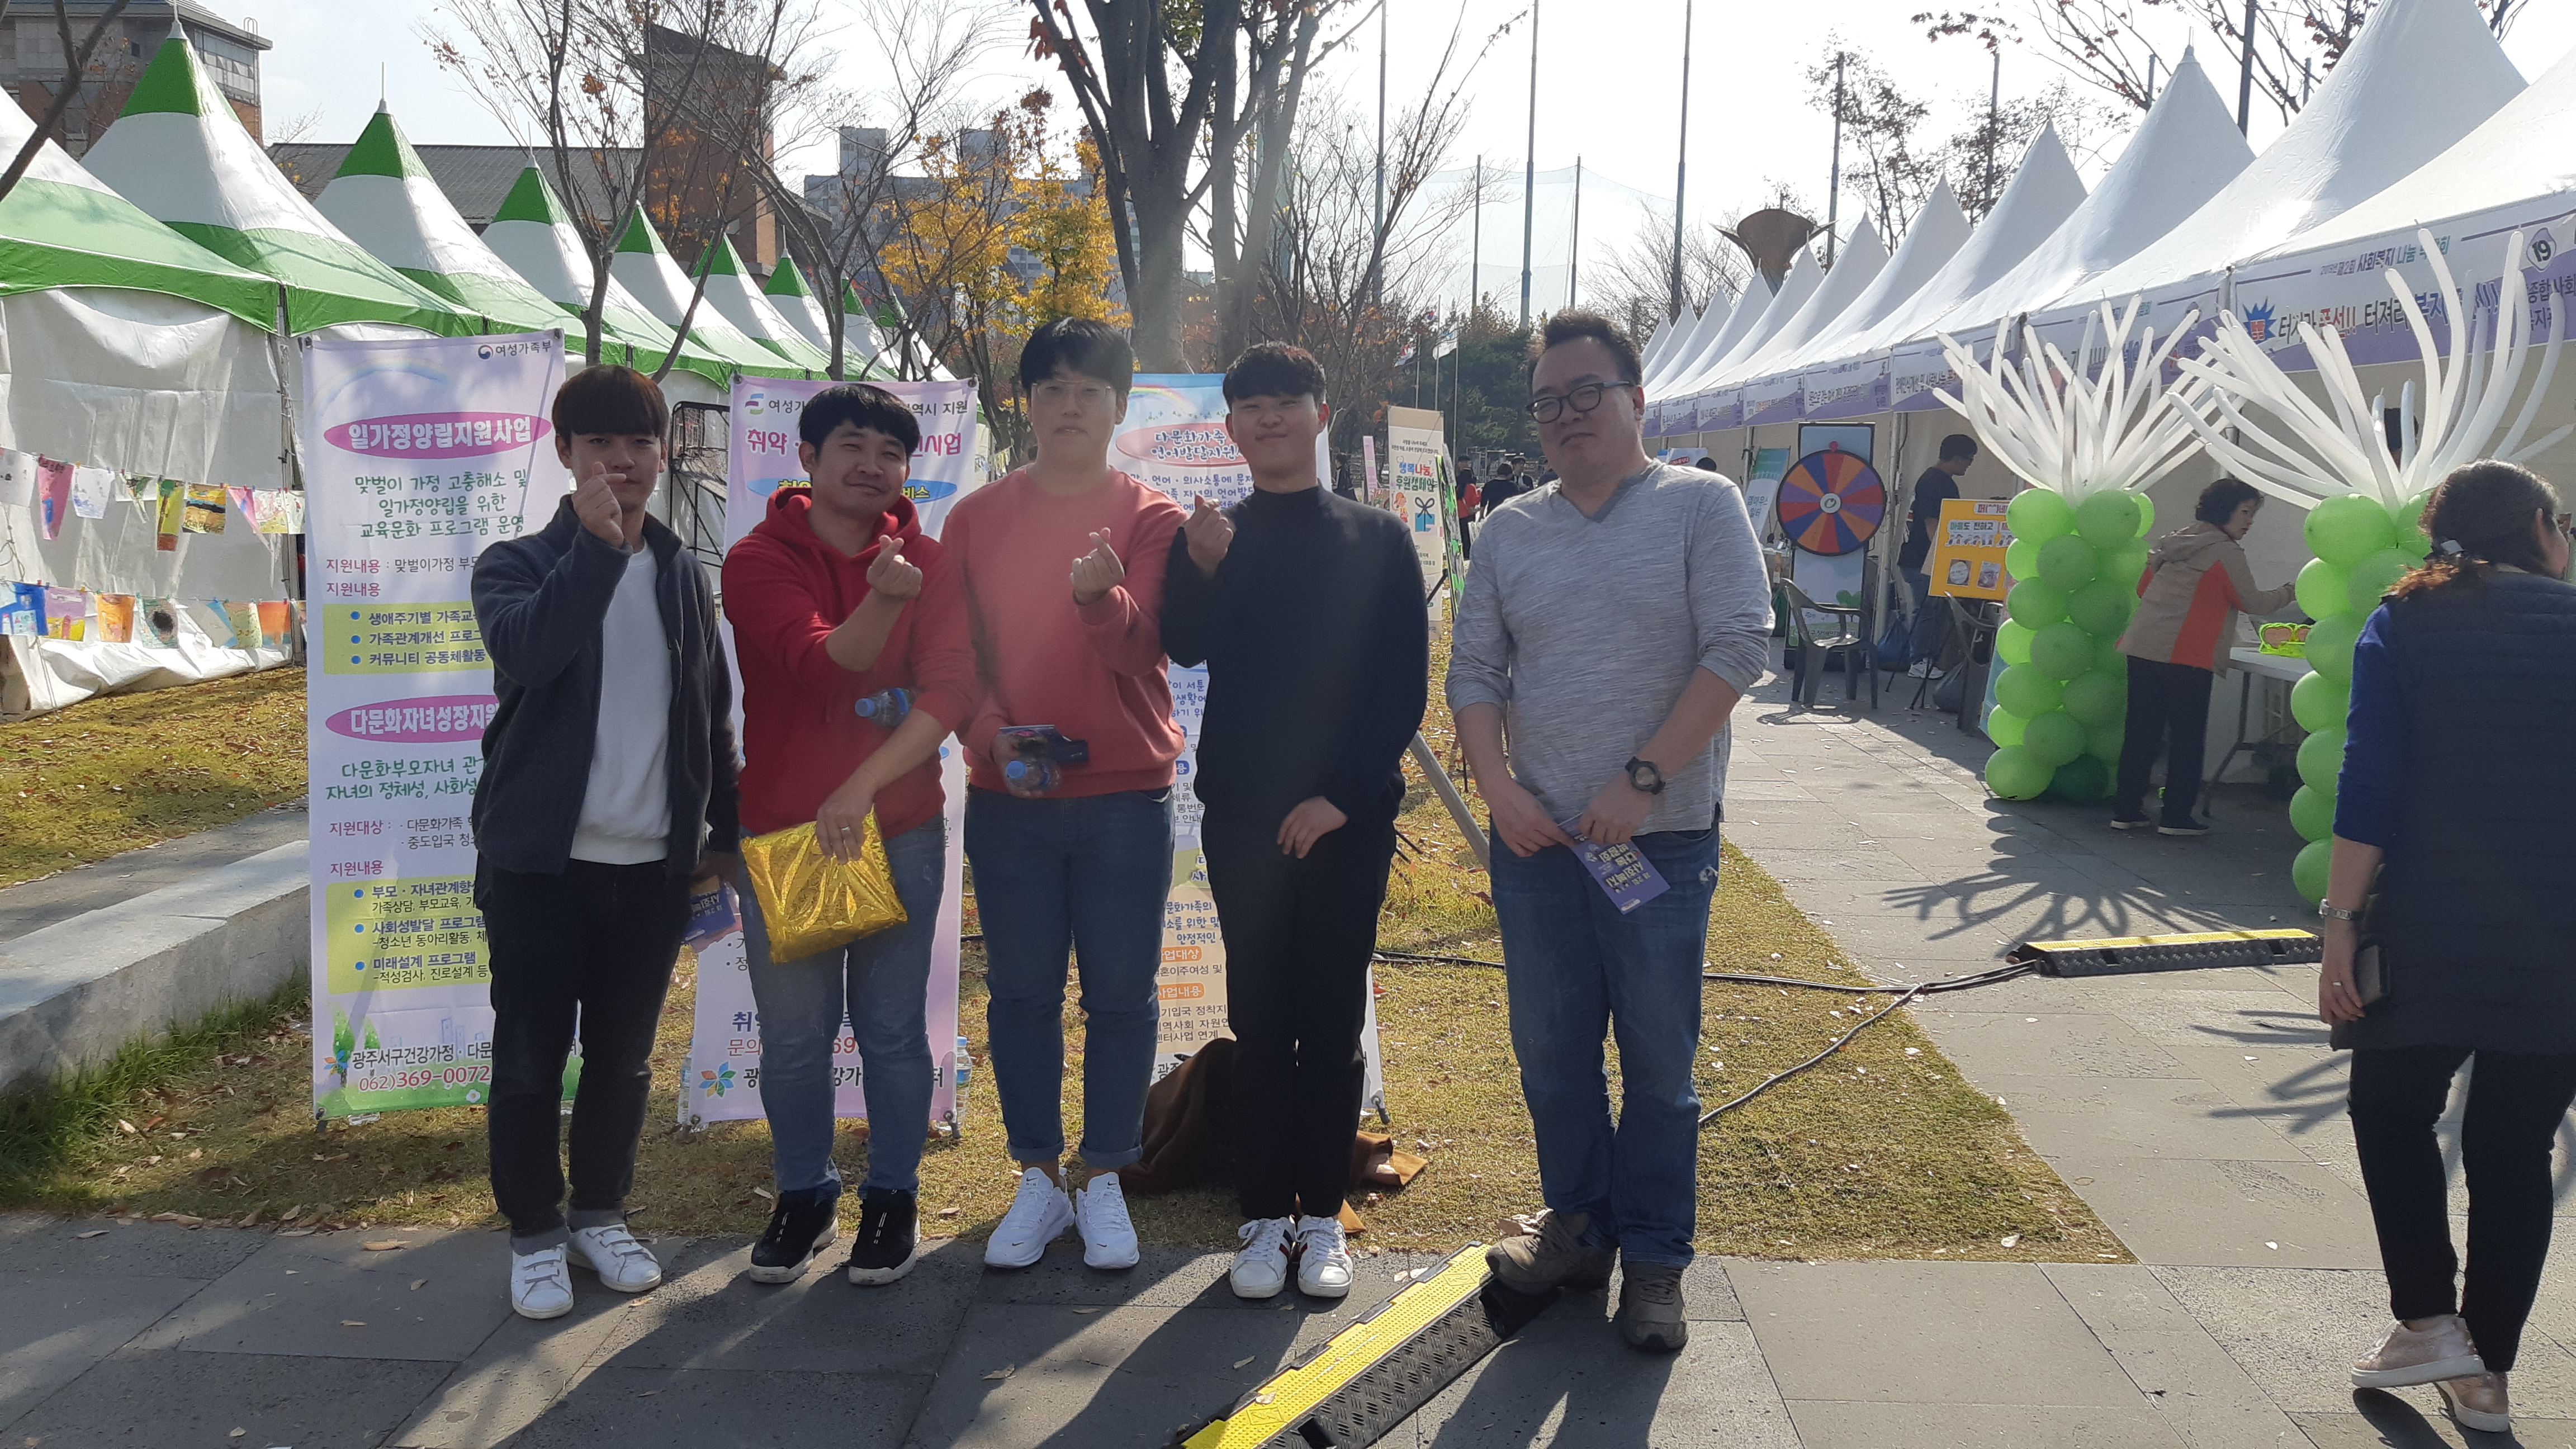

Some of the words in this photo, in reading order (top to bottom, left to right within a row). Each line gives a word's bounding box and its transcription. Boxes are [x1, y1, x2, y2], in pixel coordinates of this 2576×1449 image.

[2532, 240, 2551, 262] 19
[2357, 248, 2395, 272] 사회복지
[495, 340, 552, 357] 여성가족부
[907, 402, 936, 416] 역시
[943, 400, 968, 415] 지원
[348, 416, 532, 450] 일가정양립지원사업
[748, 429, 787, 454] 취약
[1155, 429, 1226, 445] 다문화가족
[355, 475, 402, 495] 맞벌이
[410, 475, 440, 491] 가정
[448, 471, 507, 491] 고충해소
[514, 469, 527, 489] 및
[1152, 475, 1171, 486] 언어
[1183, 474, 1232, 487] 의사소통에
[379, 495, 470, 518] 일가정양립을
[477, 493, 507, 513] 위한
[360, 520, 422, 539] 교육문화
[429, 517, 489, 537] 프로그램
[497, 514, 524, 534] 운영
[326, 558, 381, 574] 지원내용
[395, 557, 454, 572] 맞벌이가정
[326, 583, 381, 597] 지원내용
[368, 611, 432, 626] 생애주기별
[437, 610, 477, 623] 가족교
[369, 631, 445, 645] 가족관계개선
[369, 652, 419, 665] 커뮤니티
[424, 648, 486, 664] 공동체활동
[1186, 680, 1205, 692] 서툰
[342, 758, 454, 779] 다문화부모자녀
[326, 784, 372, 800] 자녀의
[379, 780, 429, 800] 정체성,
[330, 819, 383, 836] 지원대상
[407, 817, 463, 831] 다문화가족
[1182, 815, 1201, 823] 안내
[408, 834, 454, 849] 중도입국
[330, 860, 384, 877] 지원내용
[1604, 861, 1644, 888] 사회복지
[372, 885, 397, 899] 부모
[372, 900, 415, 915] 가족상담,
[419, 897, 461, 911] 부모교육,
[1166, 900, 1212, 915] 문화가족의
[372, 918, 434, 934] 사회성발달
[1163, 916, 1182, 930] 소를
[1186, 916, 1206, 928] 위한
[1210, 916, 1219, 927] 및
[415, 931, 472, 947] 동아리활동,
[1177, 932, 1215, 945] 안정적인
[373, 955, 423, 969] 미래설계
[427, 951, 476, 966] 프로그램
[1213, 964, 1222, 973] 및
[430, 966, 473, 981] 진로설계
[477, 965, 488, 978] 등
[1159, 1006, 1191, 1017] 기입국
[1159, 1020, 1194, 1031] 역사회
[727, 1039, 761, 1056] 문의
[352, 1044, 454, 1069] 광주서구건강가정
[359, 1065, 491, 1091] 062)369-0072
